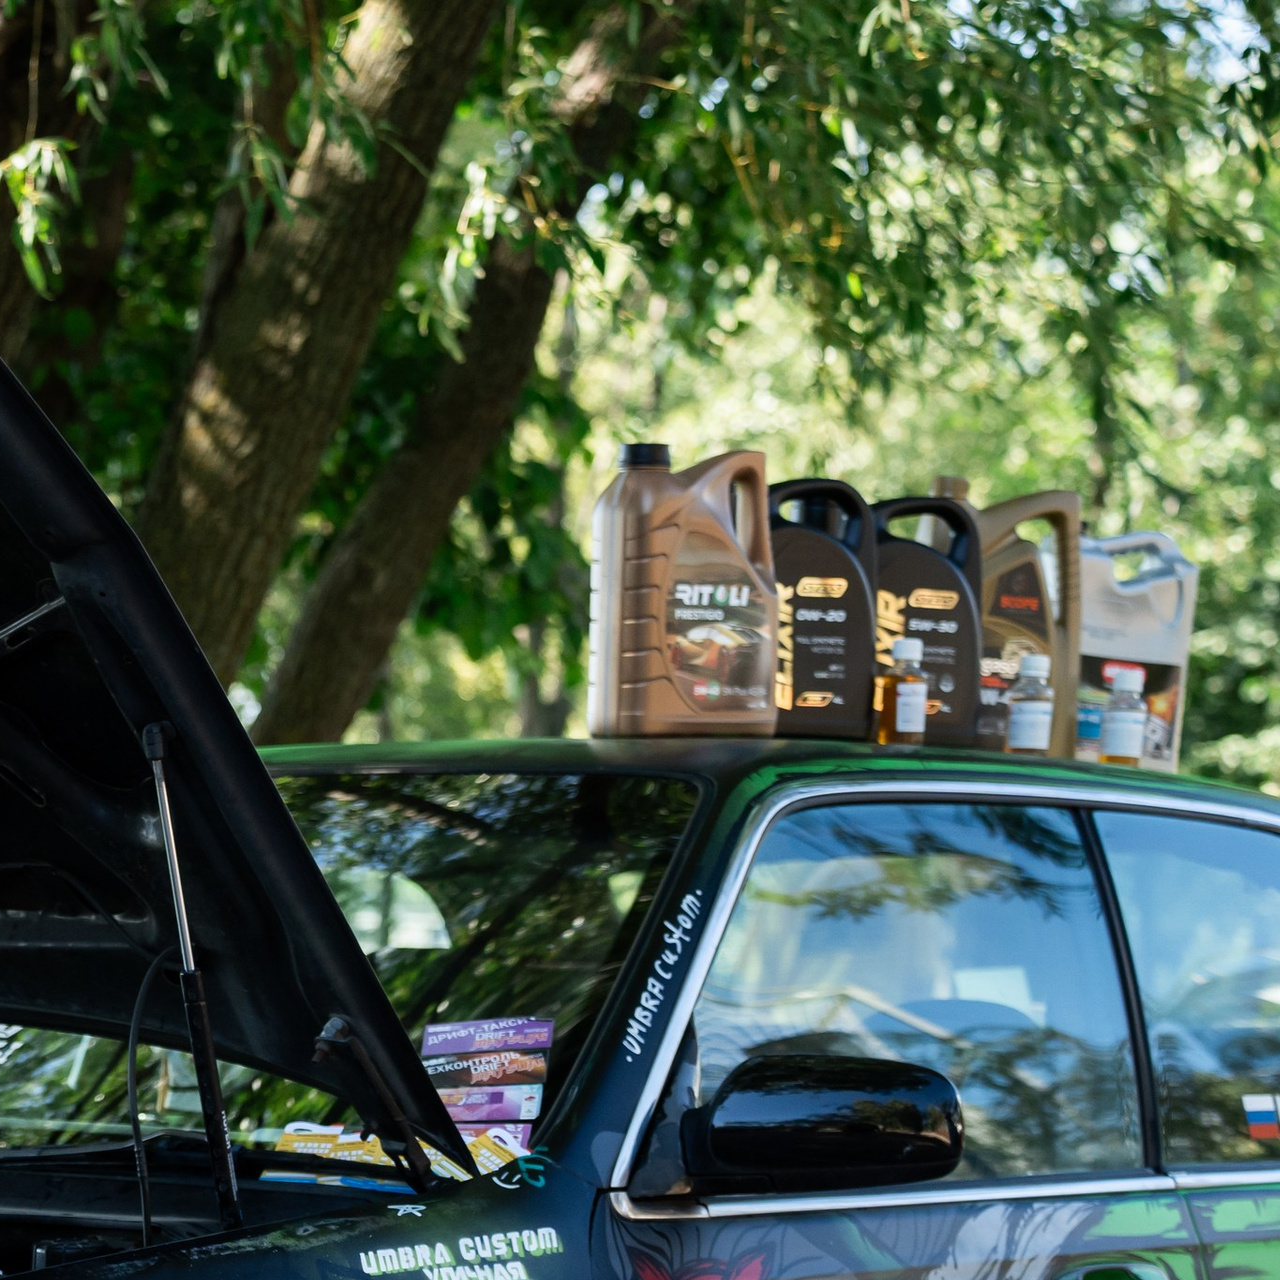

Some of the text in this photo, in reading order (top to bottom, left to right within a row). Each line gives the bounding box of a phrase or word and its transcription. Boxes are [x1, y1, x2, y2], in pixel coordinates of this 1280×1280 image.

[426, 1051, 520, 1075] ЕХКОНТРОЛЬ
[360, 1227, 561, 1275] UMBRA CUSTOM
